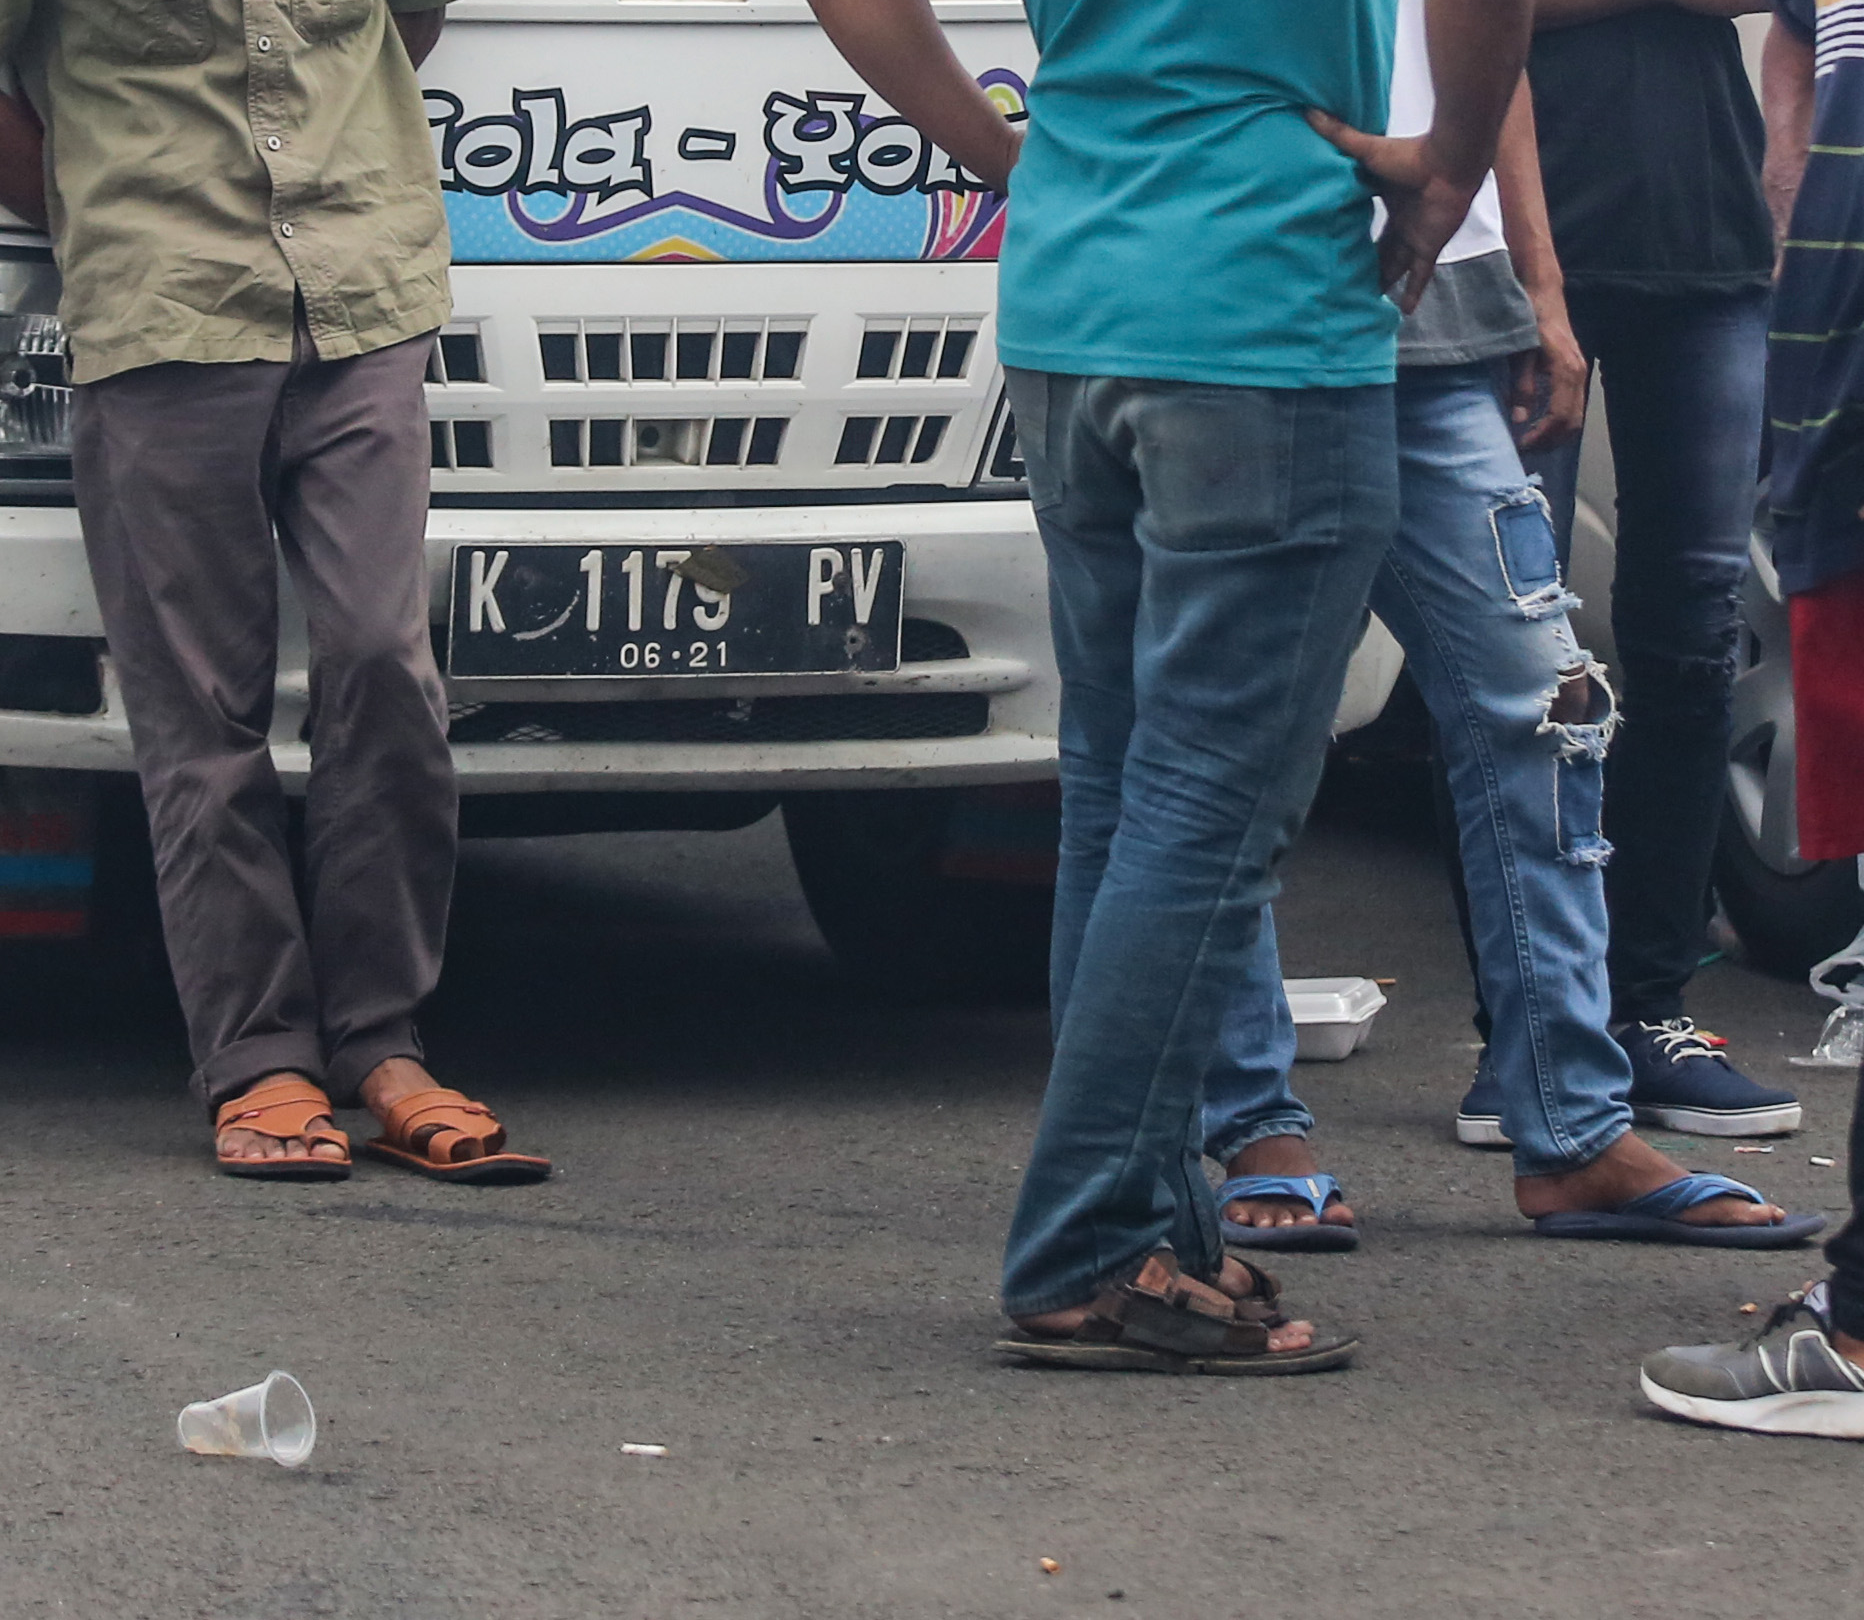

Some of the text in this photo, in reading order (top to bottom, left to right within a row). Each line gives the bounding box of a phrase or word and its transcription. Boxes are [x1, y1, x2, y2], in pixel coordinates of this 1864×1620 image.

[468, 546, 885, 633] K 1179 PV
